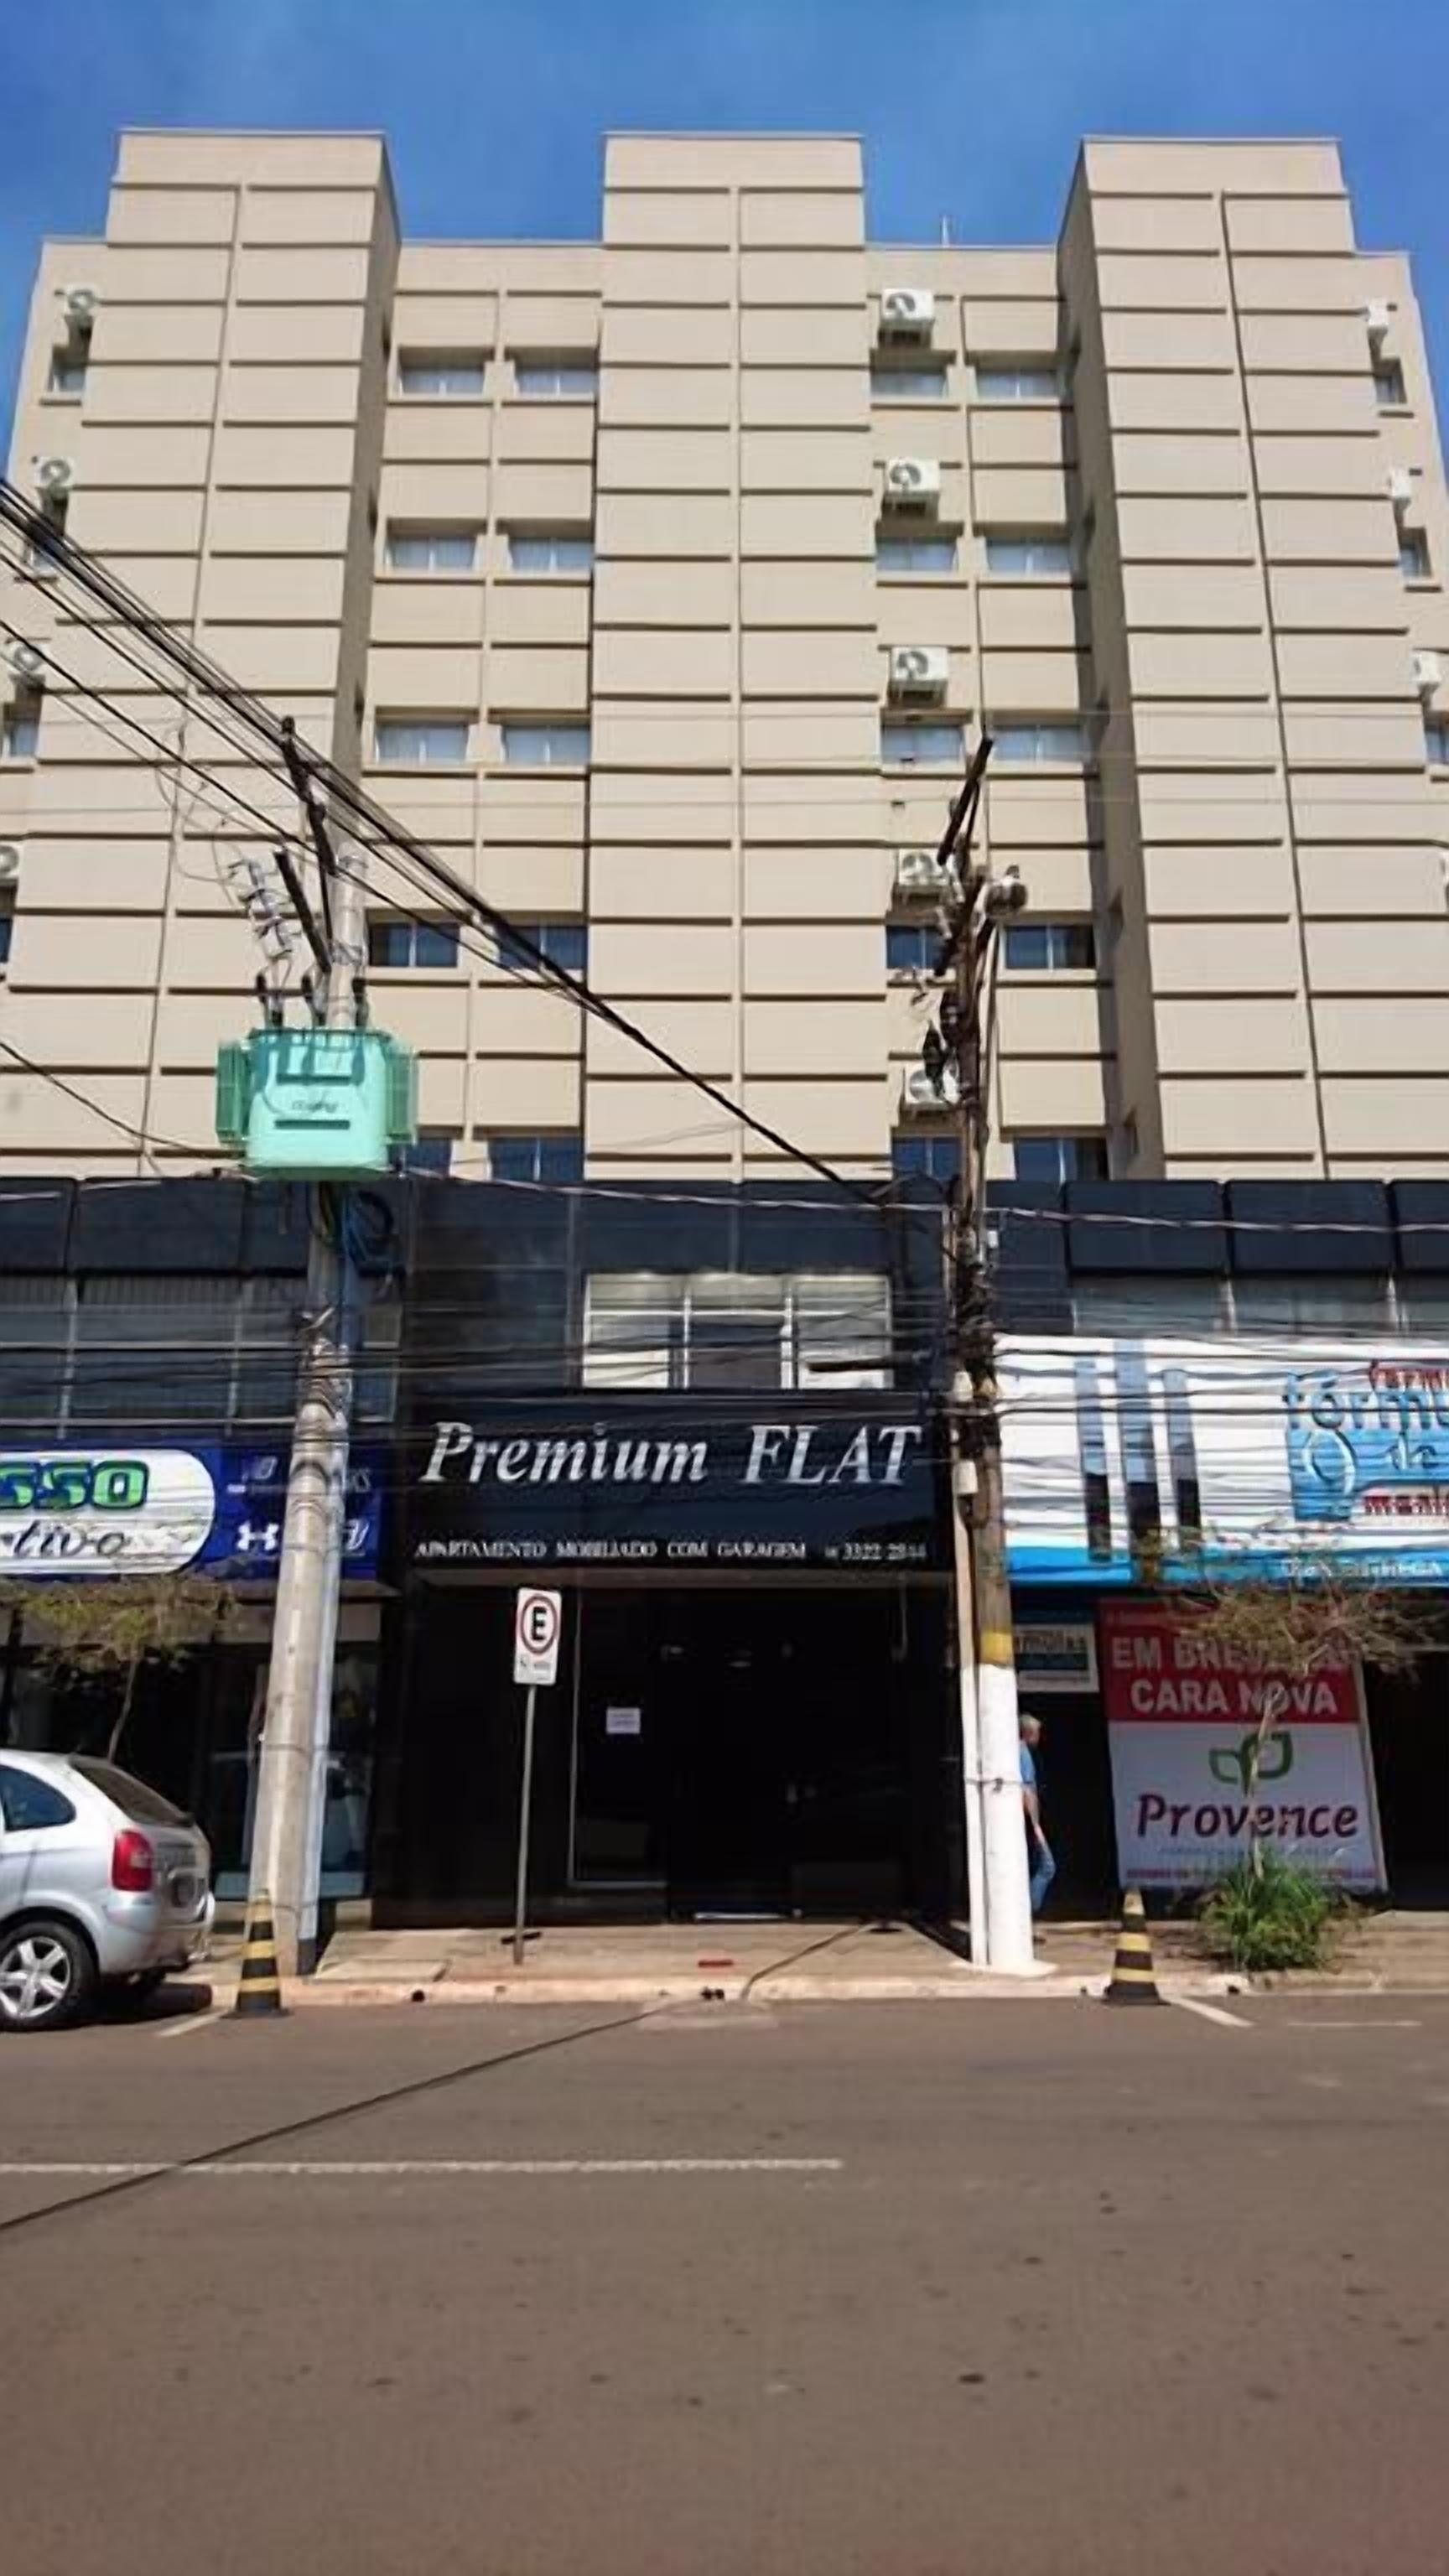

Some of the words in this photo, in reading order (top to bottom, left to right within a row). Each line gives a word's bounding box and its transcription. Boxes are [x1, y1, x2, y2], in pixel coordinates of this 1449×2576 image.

[419, 1421, 709, 1483] Premium
[744, 1424, 922, 1484] FLAT
[416, 1540, 547, 1558] APARTAMENTO
[556, 1540, 657, 1557] MOBILIADO
[667, 1541, 708, 1557] COM
[717, 1541, 806, 1558] GARAGEM
[531, 1605, 547, 1641] E
[1110, 1636, 1162, 1671] EM
[1130, 1678, 1229, 1714] CARA
[1239, 1680, 1338, 1715] NOVA
[1137, 1794, 1359, 1838] Provence
